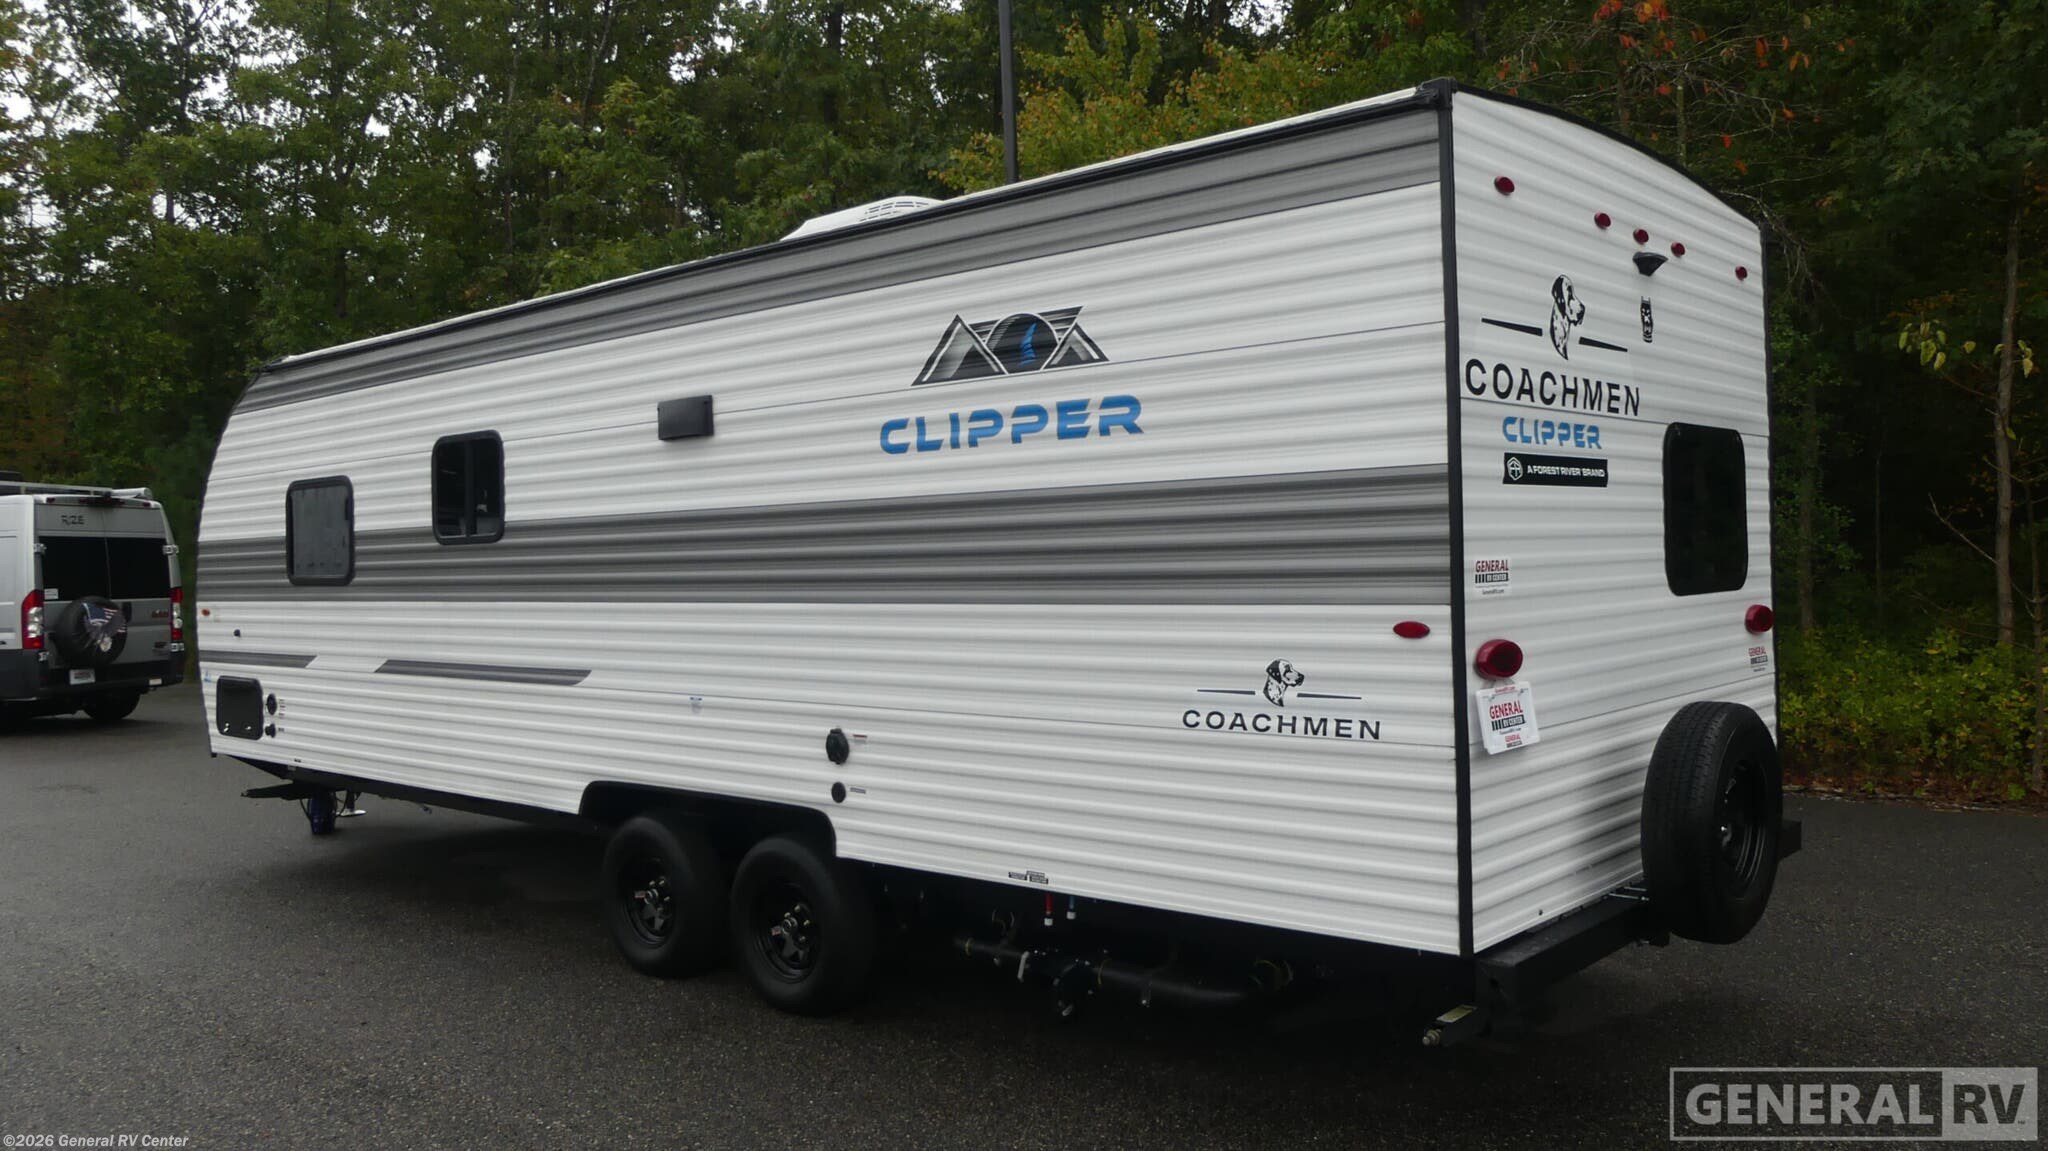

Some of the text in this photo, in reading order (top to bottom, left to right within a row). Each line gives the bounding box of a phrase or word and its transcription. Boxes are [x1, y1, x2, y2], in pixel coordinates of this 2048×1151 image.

[1465, 358, 1640, 417] COACHMEN
[880, 394, 1144, 455] CLIPPER
[1502, 416, 1602, 449] CLIPPER
[1527, 464, 1605, 478] A FOREST RIVER BRAND
[1475, 559, 1509, 573] GENERAL
[1182, 709, 1381, 740] COACHMEN
[1489, 700, 1524, 720] GENERAL
